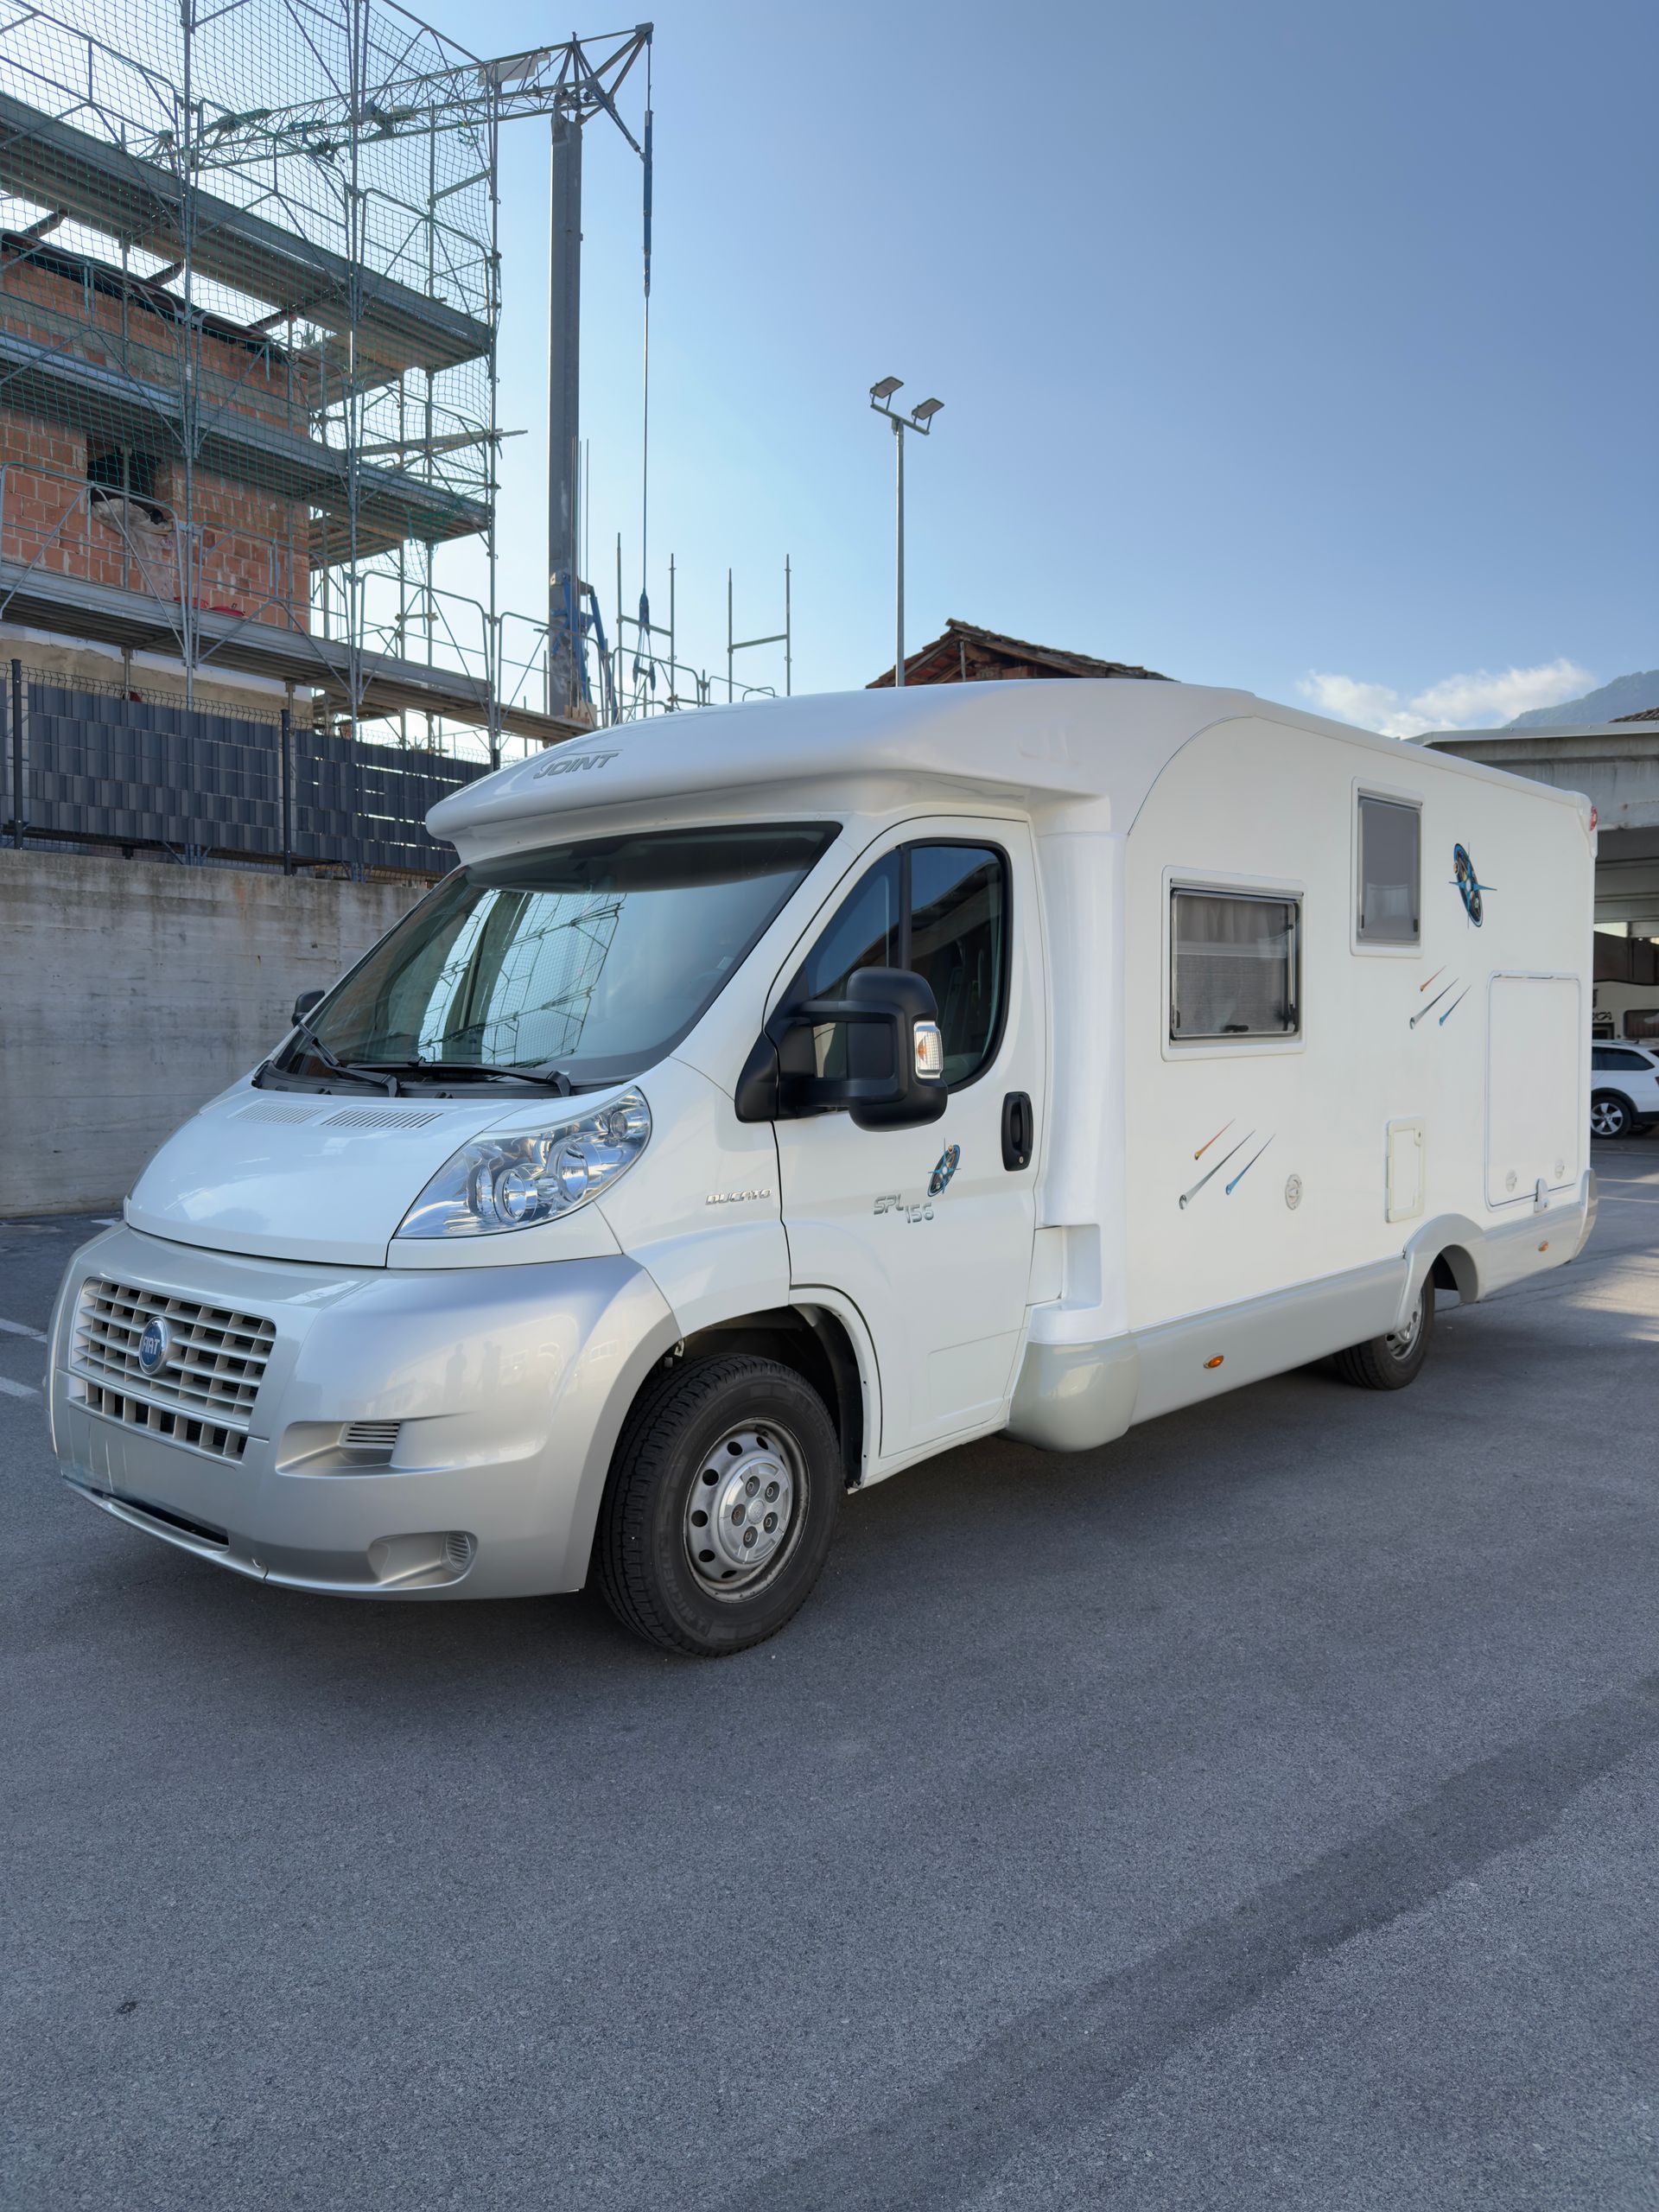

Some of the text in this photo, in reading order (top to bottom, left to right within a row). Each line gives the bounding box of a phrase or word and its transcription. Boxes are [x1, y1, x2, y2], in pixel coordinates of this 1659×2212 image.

[533, 753, 619, 779] JOINT
[705, 1189, 771, 1205] DUCATO
[906, 1203, 934, 1224] 156
[143, 1336, 161, 1355] FIAT
